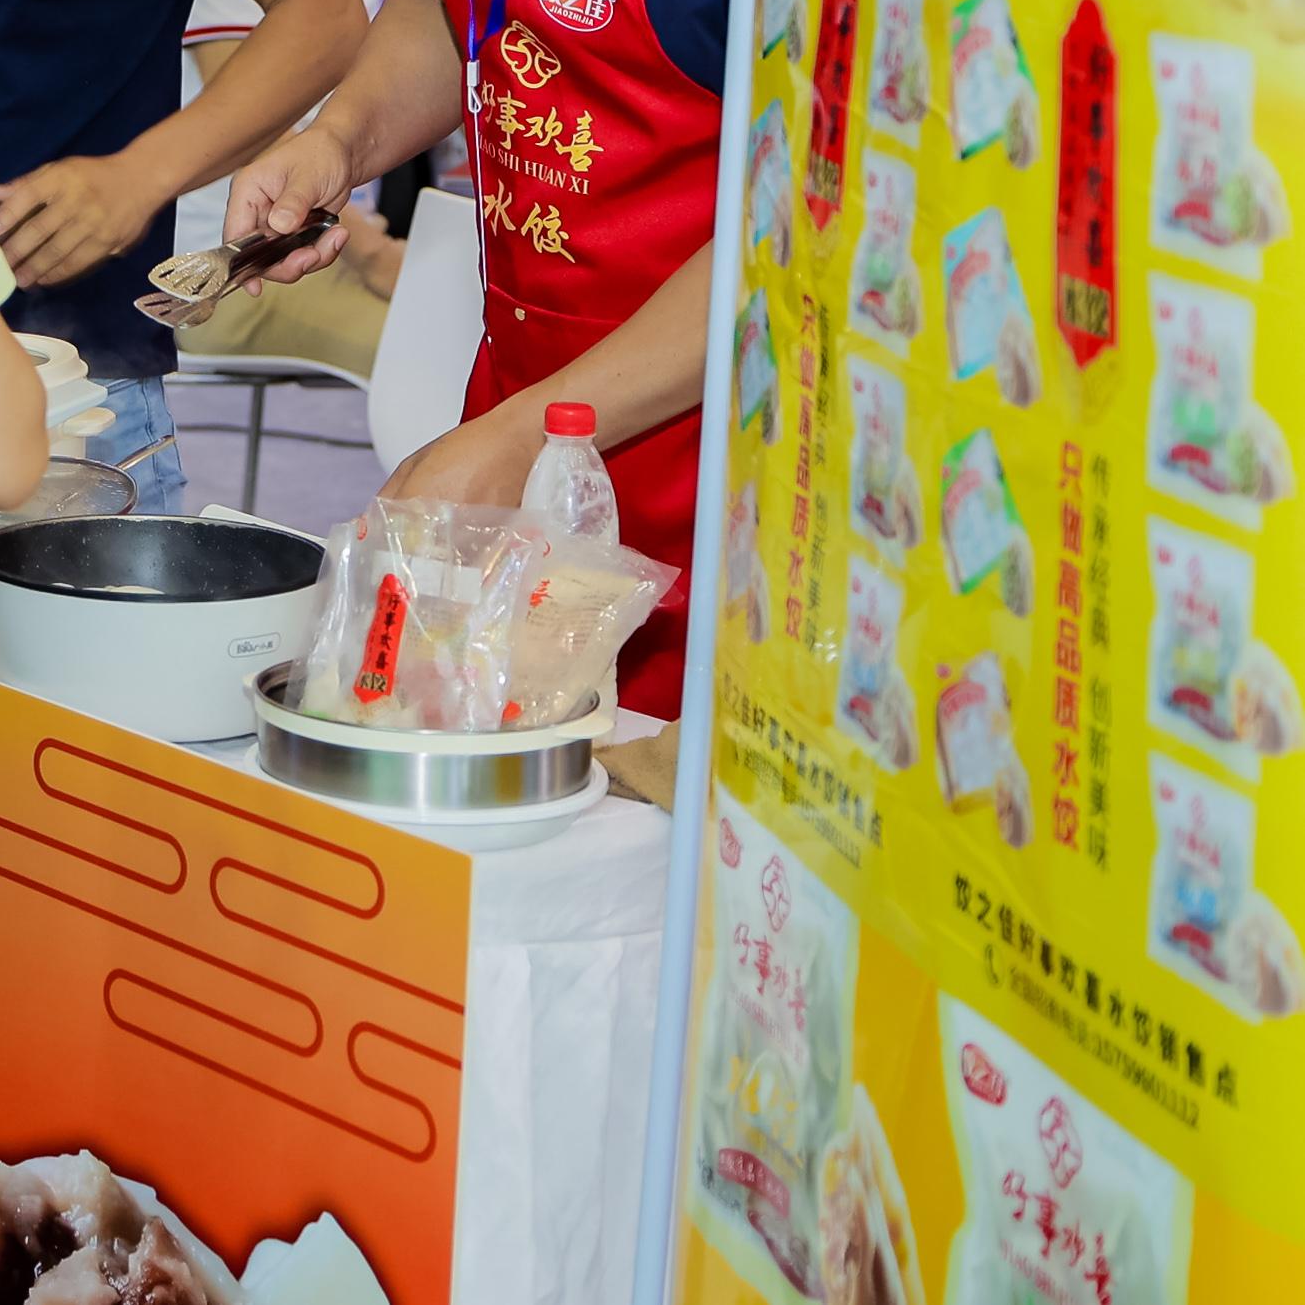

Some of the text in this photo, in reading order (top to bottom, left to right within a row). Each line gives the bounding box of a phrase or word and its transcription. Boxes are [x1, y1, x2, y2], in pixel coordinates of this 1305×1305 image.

[549, 5, 594, 27] JIAOZHIJIA
[481, 80, 604, 172] 好事欢喜
[498, 148, 519, 172] SHI
[525, 160, 566, 189] HUAN
[569, 175, 589, 195] XI
[484, 178, 576, 263] 水饺
